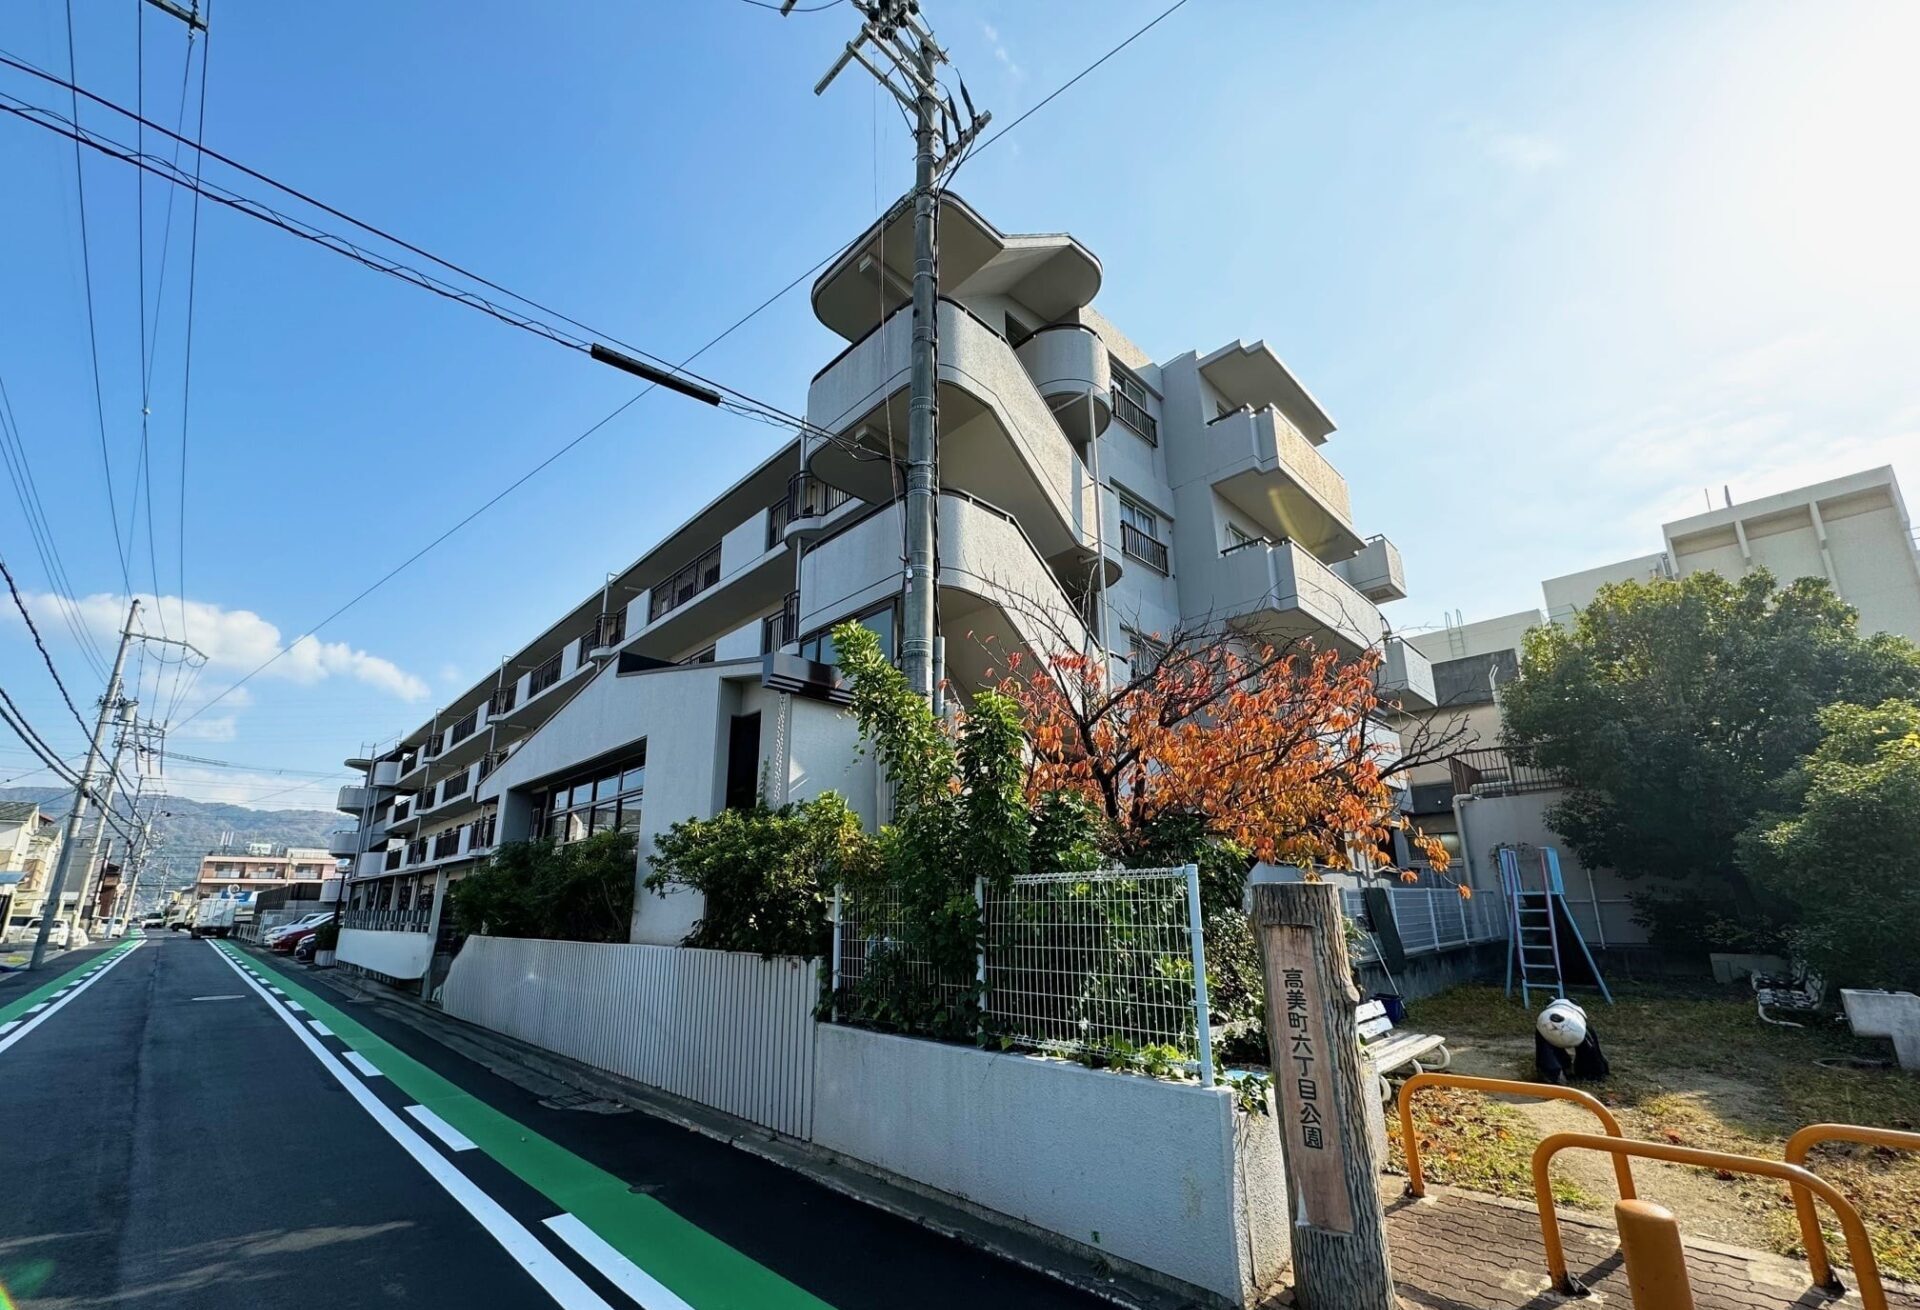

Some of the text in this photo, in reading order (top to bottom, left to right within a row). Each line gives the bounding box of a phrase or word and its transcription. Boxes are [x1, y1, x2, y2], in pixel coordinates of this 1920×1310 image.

[1282, 968, 1323, 1149] 高美町六丁目公園
